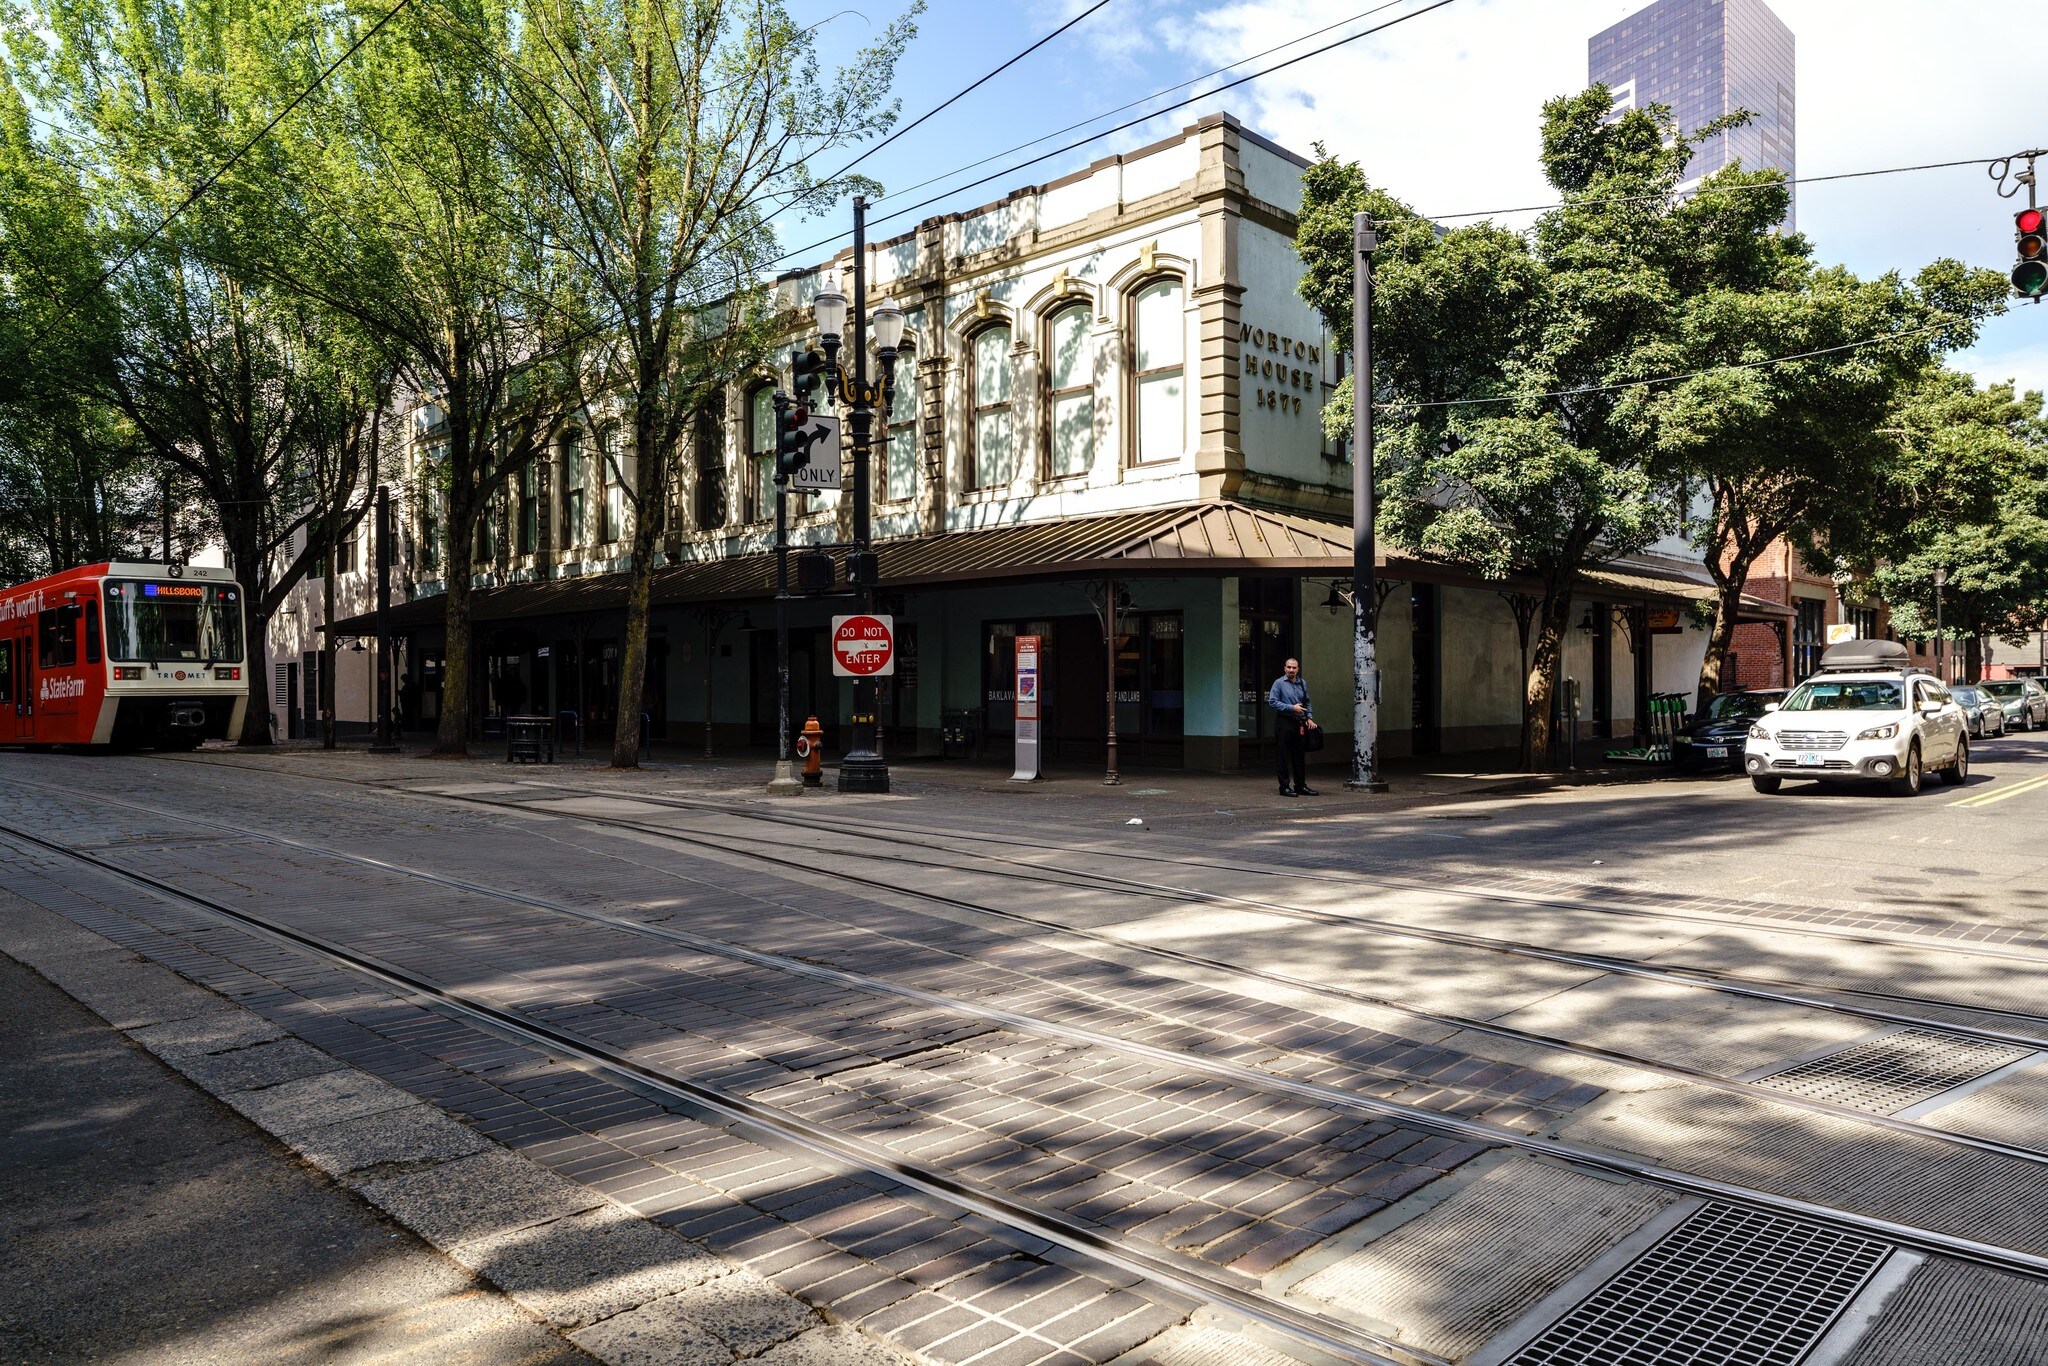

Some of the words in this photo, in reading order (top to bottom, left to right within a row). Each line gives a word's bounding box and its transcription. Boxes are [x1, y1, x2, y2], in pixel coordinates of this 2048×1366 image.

[1240, 322, 1320, 364] NORTON
[1245, 353, 1313, 391] HOUSE
[1256, 386, 1302, 413] 1877
[800, 468, 835, 483] ONLY
[156, 586, 203, 597] HILLSBORO
[16, 591, 37, 618] worth
[38, 589, 46, 613] it.
[841, 627, 855, 637] DO
[864, 627, 883, 637] NOT
[846, 654, 880, 664] ENTER
[988, 690, 1015, 701] BAKLAVA
